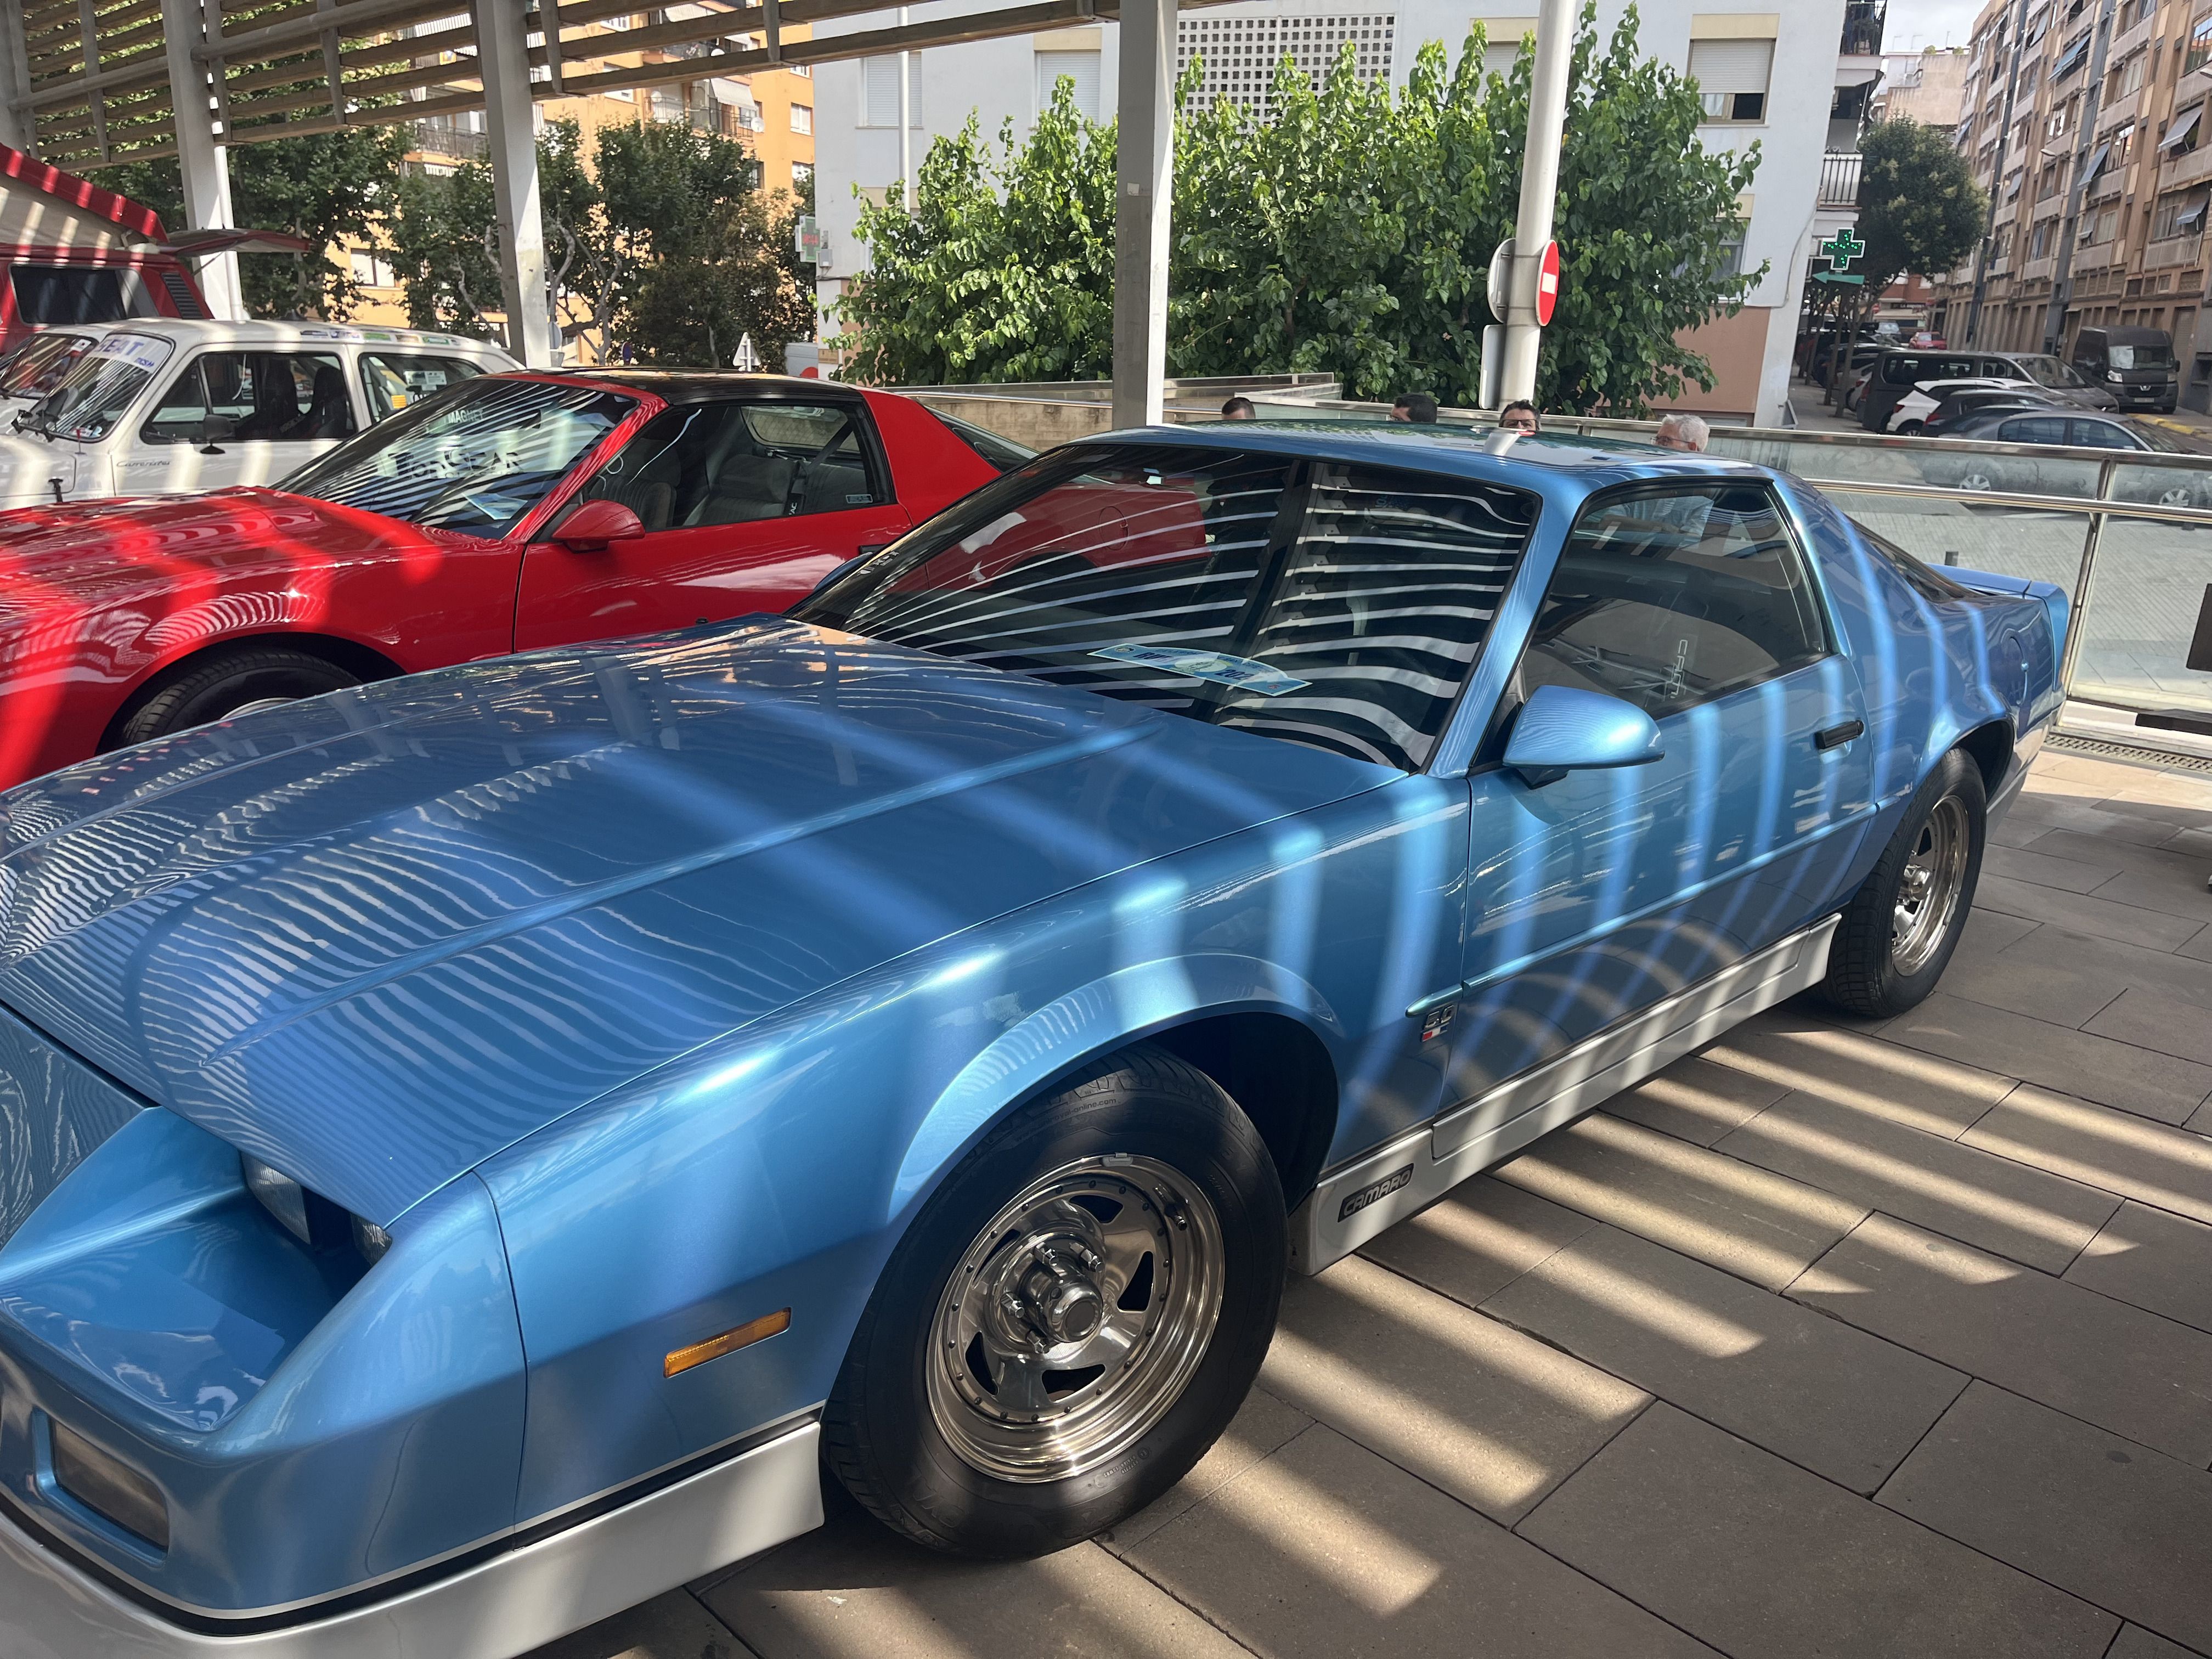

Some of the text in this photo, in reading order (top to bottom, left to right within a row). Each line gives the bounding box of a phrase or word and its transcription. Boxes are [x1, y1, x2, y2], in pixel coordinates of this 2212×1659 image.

[94, 338, 144, 356] SEAT
[1214, 669, 1264, 681] 202
[1424, 1005, 1454, 1029] 5.0
[1344, 1169, 1411, 1216] CAMARO
